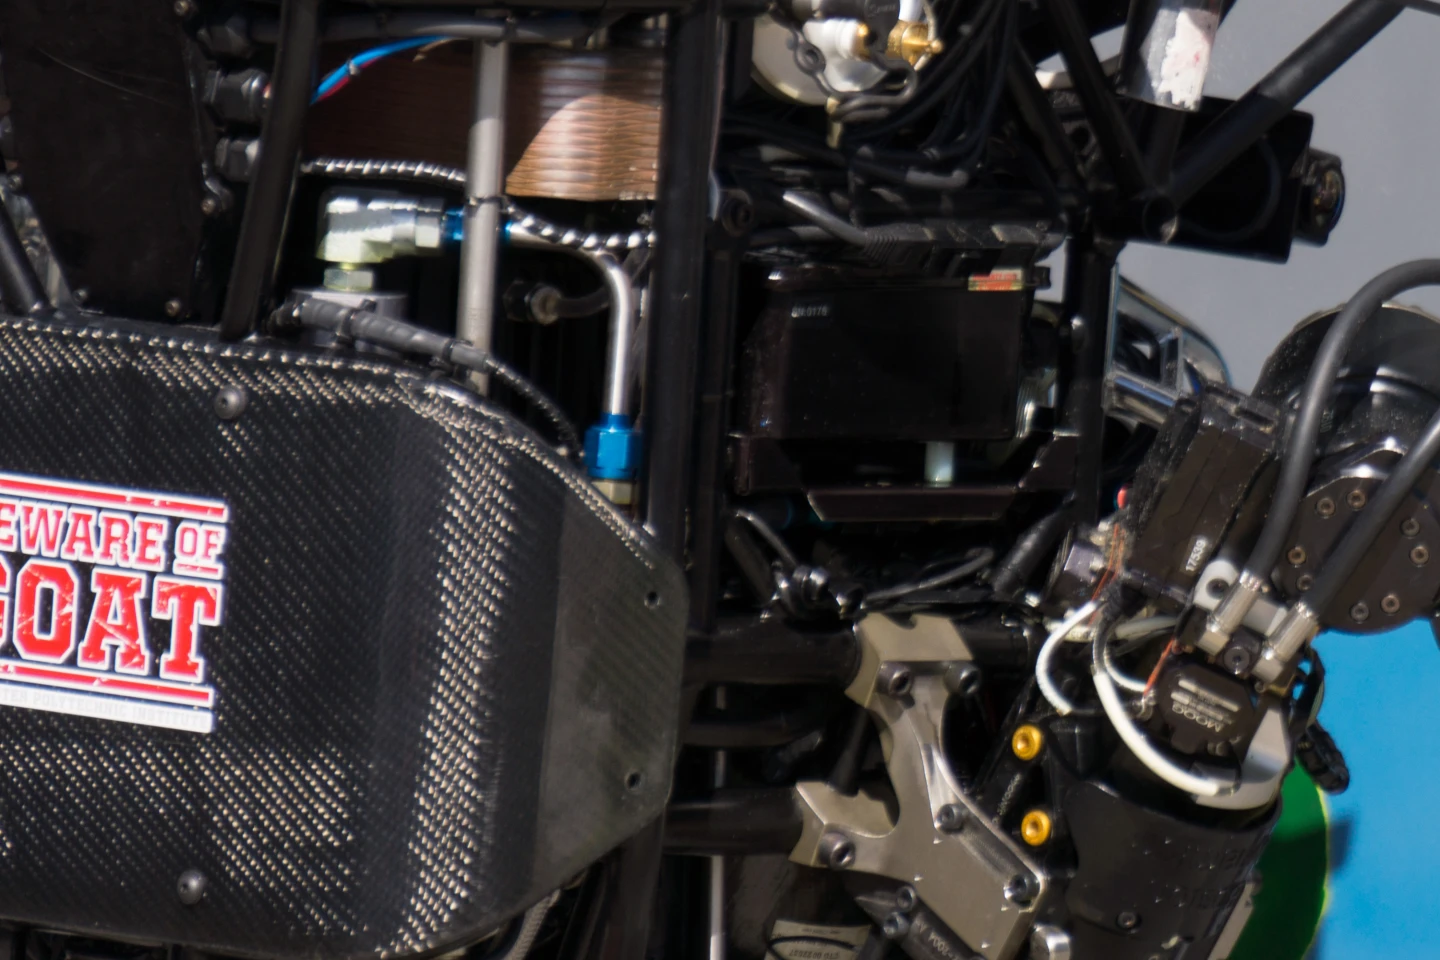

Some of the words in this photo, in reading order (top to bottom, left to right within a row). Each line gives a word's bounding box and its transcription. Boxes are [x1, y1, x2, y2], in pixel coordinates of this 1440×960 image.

[176, 520, 226, 561] OF
[0, 552, 223, 683] OAT
[1172, 700, 1224, 733] MOOG
